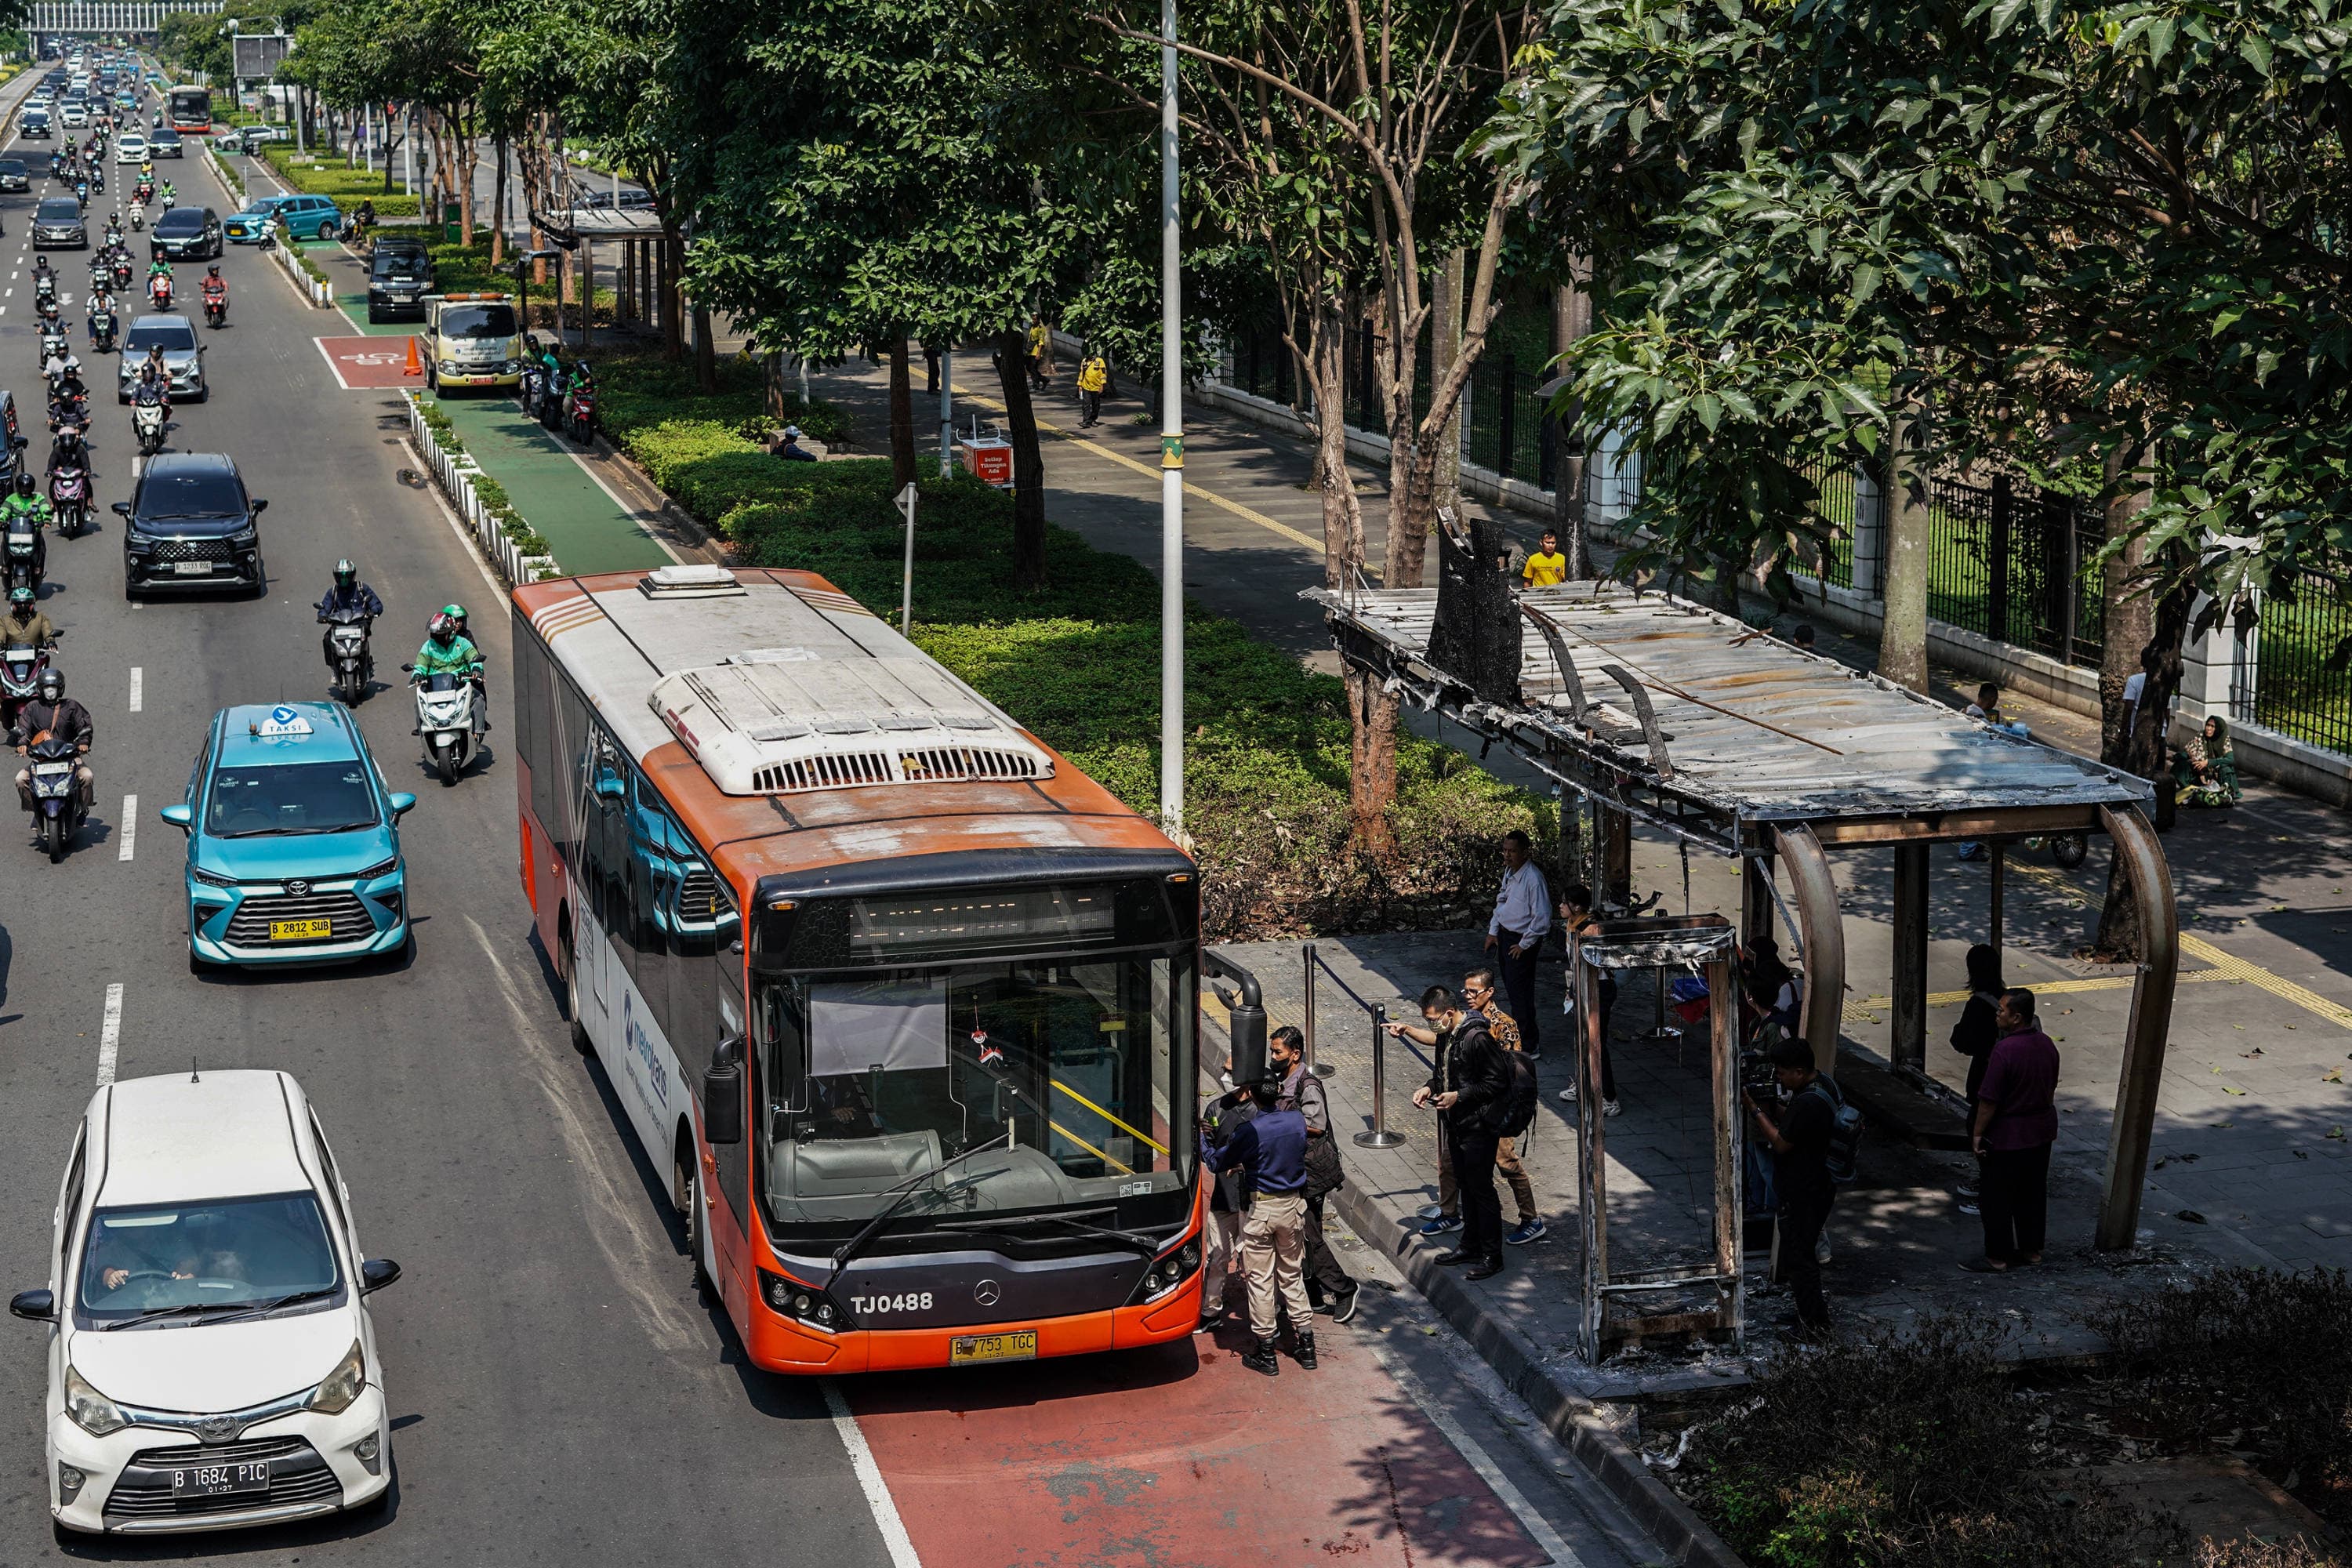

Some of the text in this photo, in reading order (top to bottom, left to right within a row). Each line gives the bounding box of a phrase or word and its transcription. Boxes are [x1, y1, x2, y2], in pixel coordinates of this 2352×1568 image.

[272, 920, 329, 934] B 2812 SUB
[634, 1020, 667, 1102] metrotrans
[850, 1291, 933, 1314] TJ0488
[955, 1334, 1034, 1355] B 7753 TGC
[174, 1464, 266, 1488] B 1684 PIC
